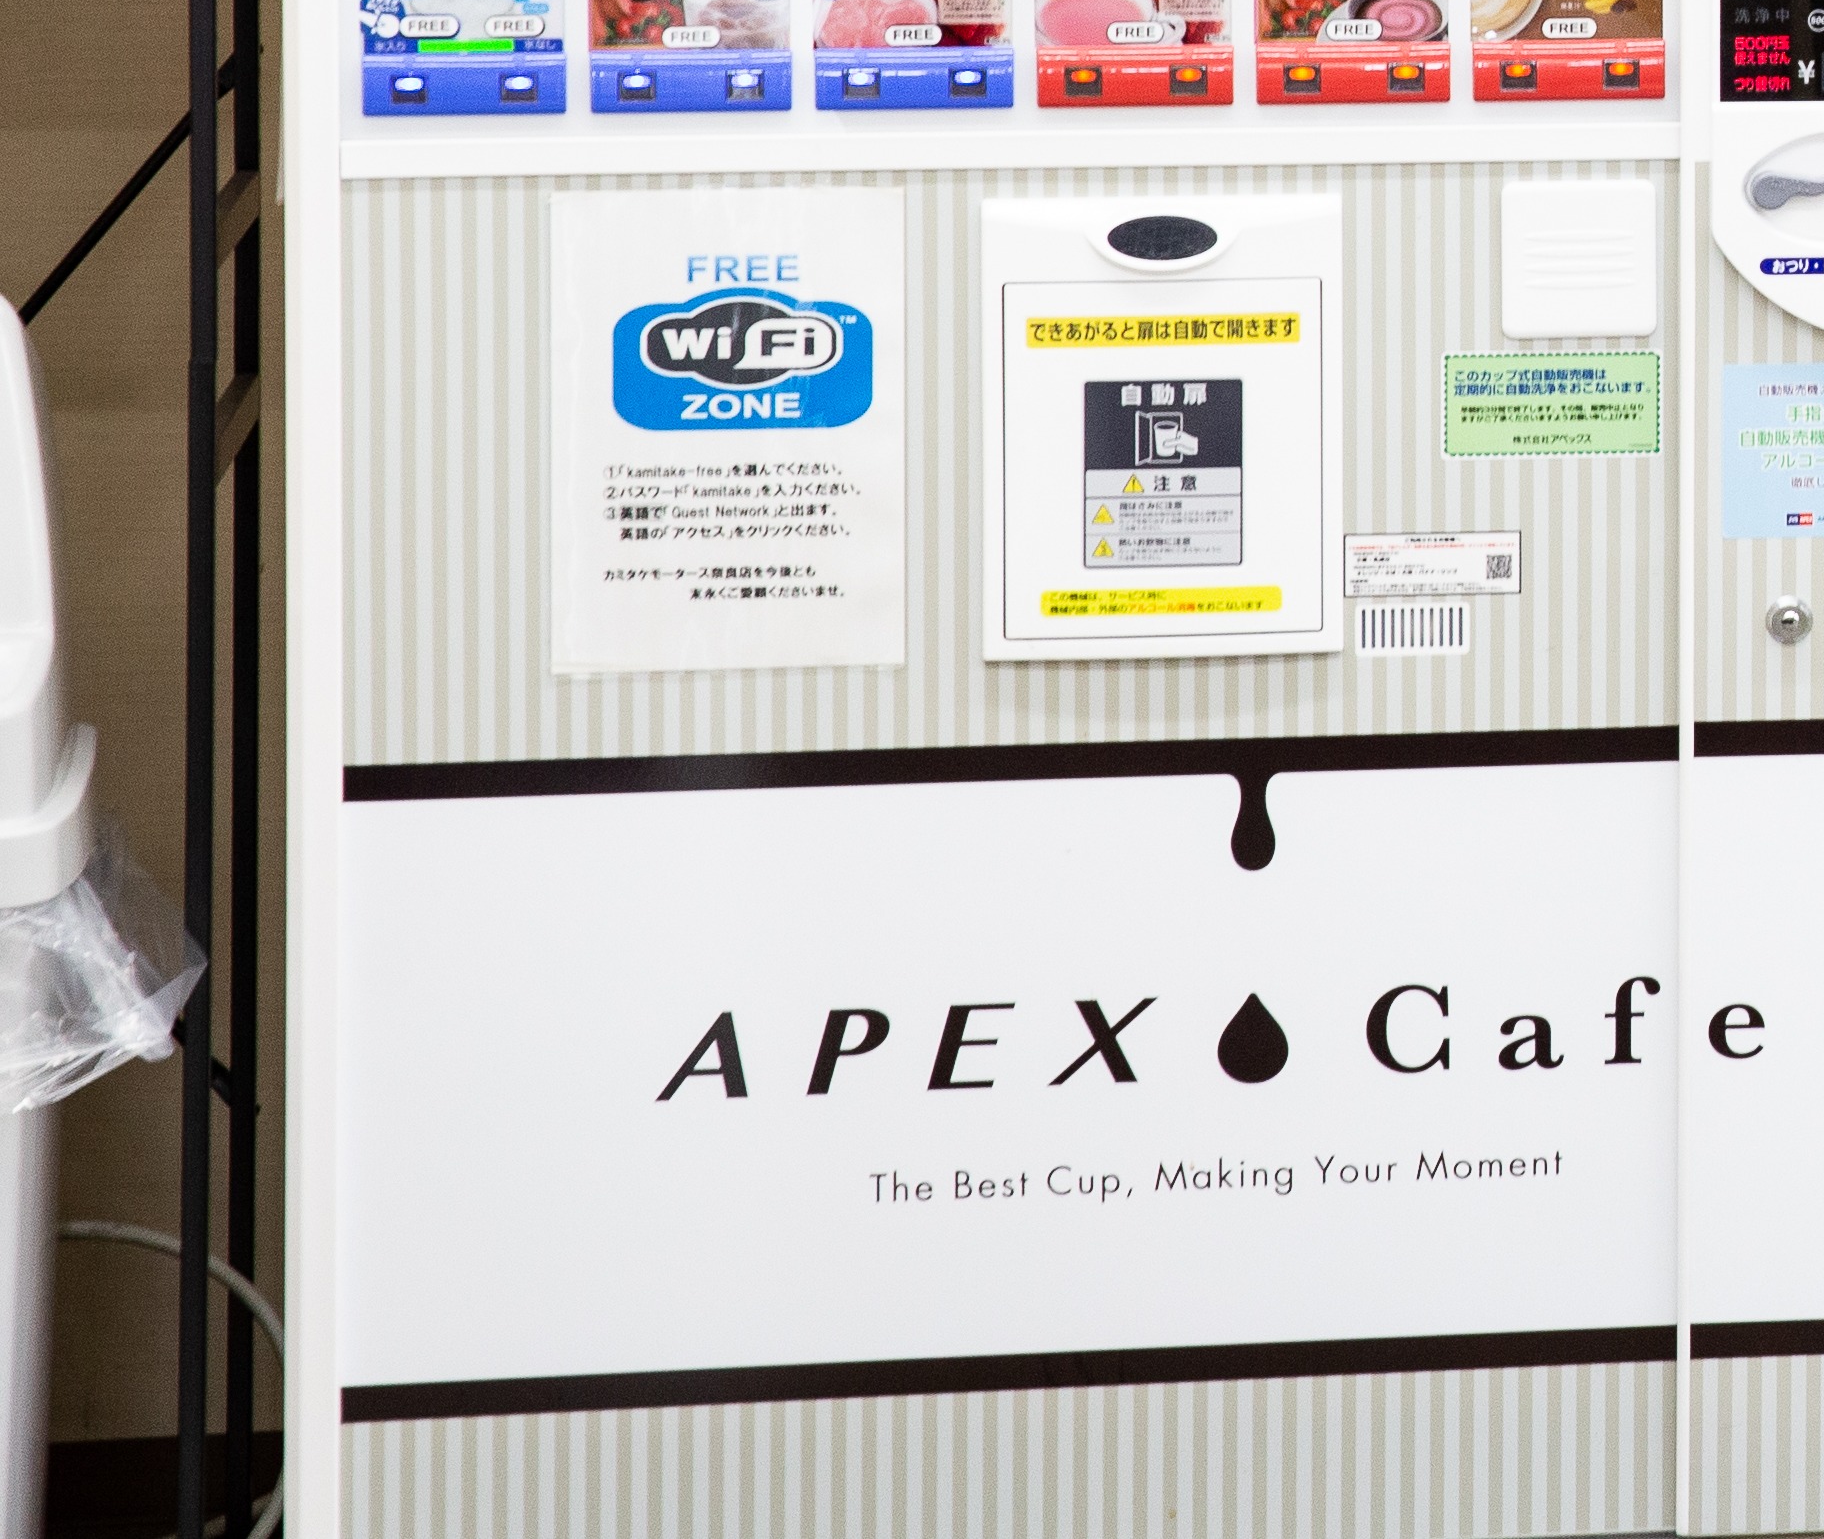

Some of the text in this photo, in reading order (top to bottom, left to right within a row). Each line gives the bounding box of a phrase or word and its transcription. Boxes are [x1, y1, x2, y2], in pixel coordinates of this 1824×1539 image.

[407, 20, 451, 33] FREE
[1549, 22, 1590, 34] FREE
[687, 255, 800, 283] FREE
[1030, 316, 1297, 342] できあがると扉は自動で開きます
[1454, 369, 1606, 383] このカップ式自動販売機は
[680, 393, 801, 420] ZONE
[1121, 382, 1207, 406] 自動扉
[1154, 475, 1197, 493] 注意
[655, 975, 1767, 1102] APEX Cafe
[869, 1148, 1564, 1204] The Best Cup, Making Your Moment
